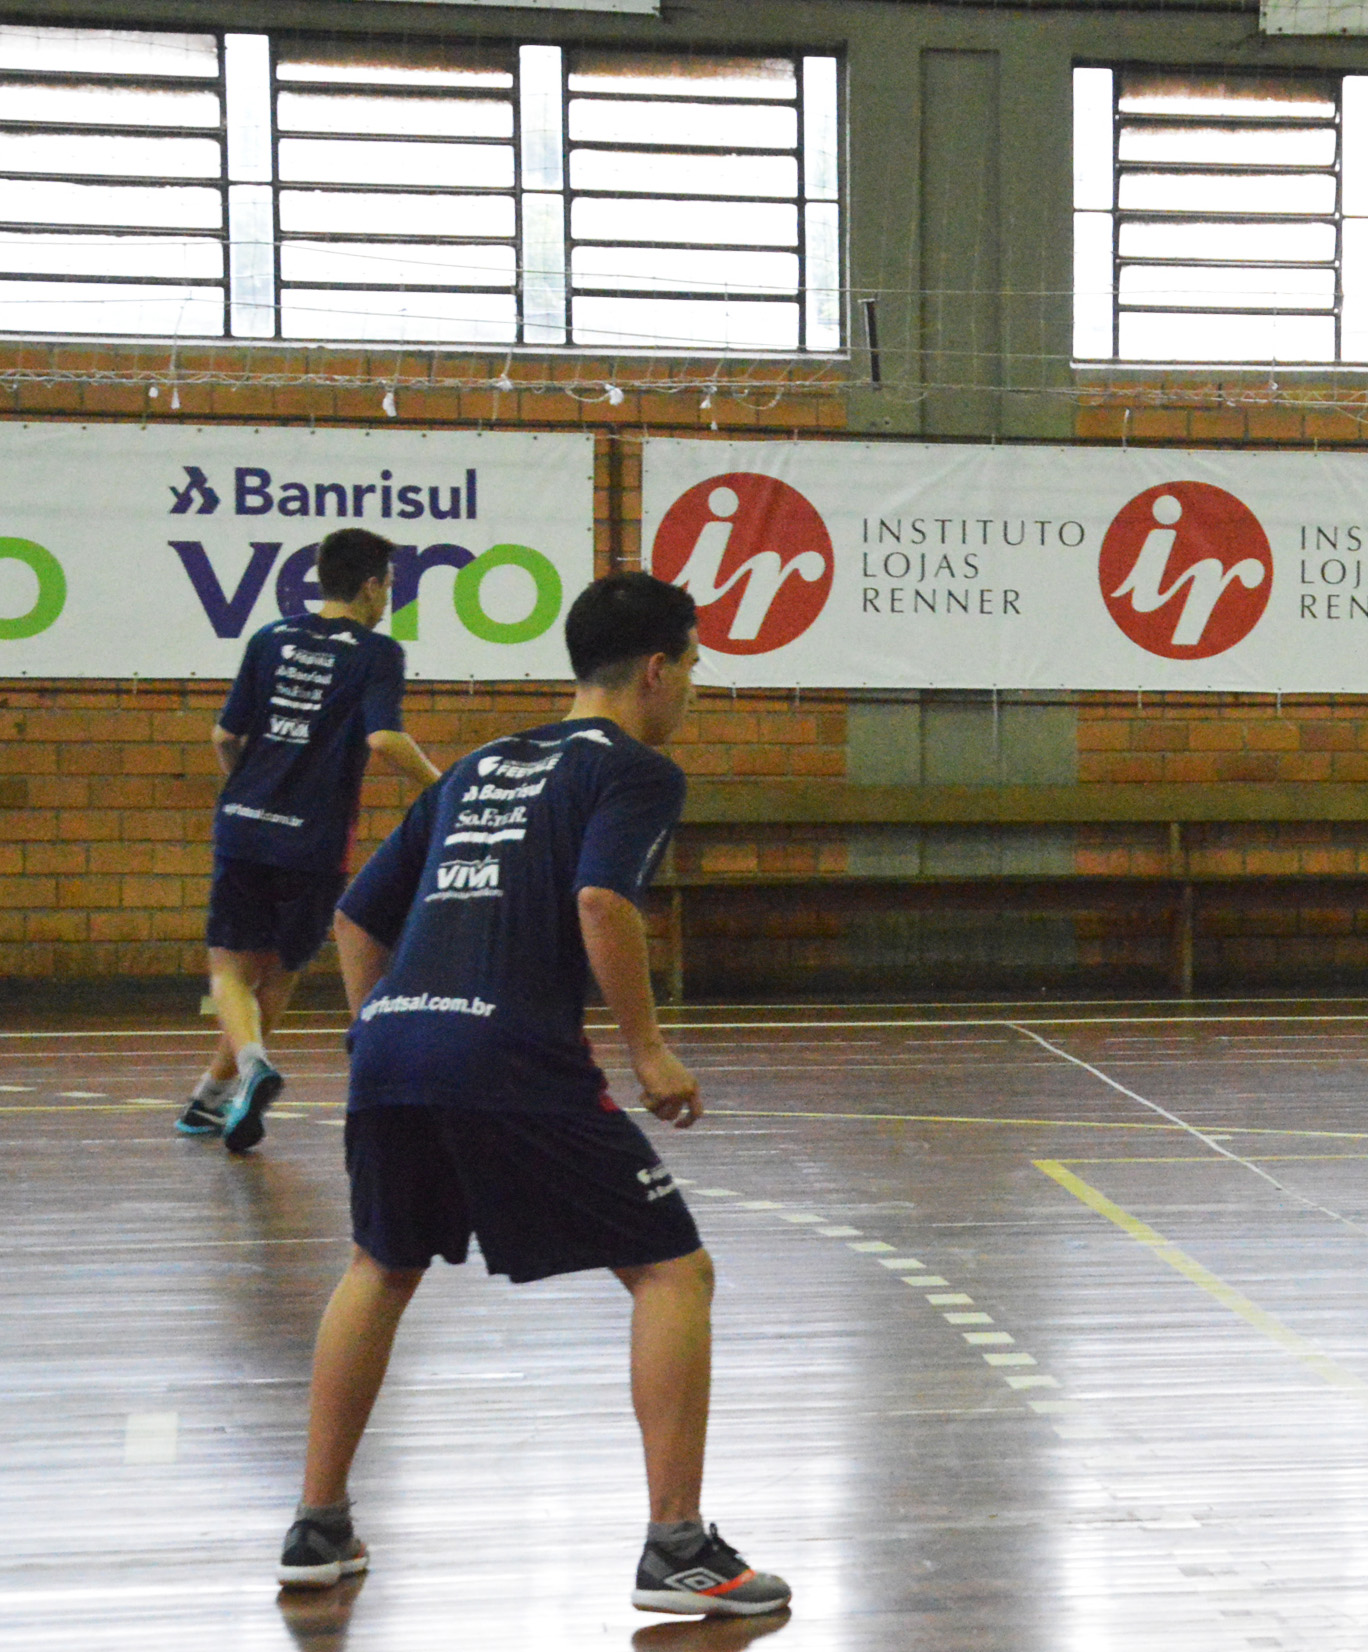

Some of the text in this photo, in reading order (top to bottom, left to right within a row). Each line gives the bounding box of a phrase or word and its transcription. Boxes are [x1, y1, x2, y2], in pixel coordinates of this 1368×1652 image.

[234, 467, 478, 520] Banrisul
[862, 518, 1086, 547] INSTITUTO
[862, 552, 980, 583] LOJAS
[862, 587, 1022, 615] RENNER
[437, 863, 500, 890] VIVA
